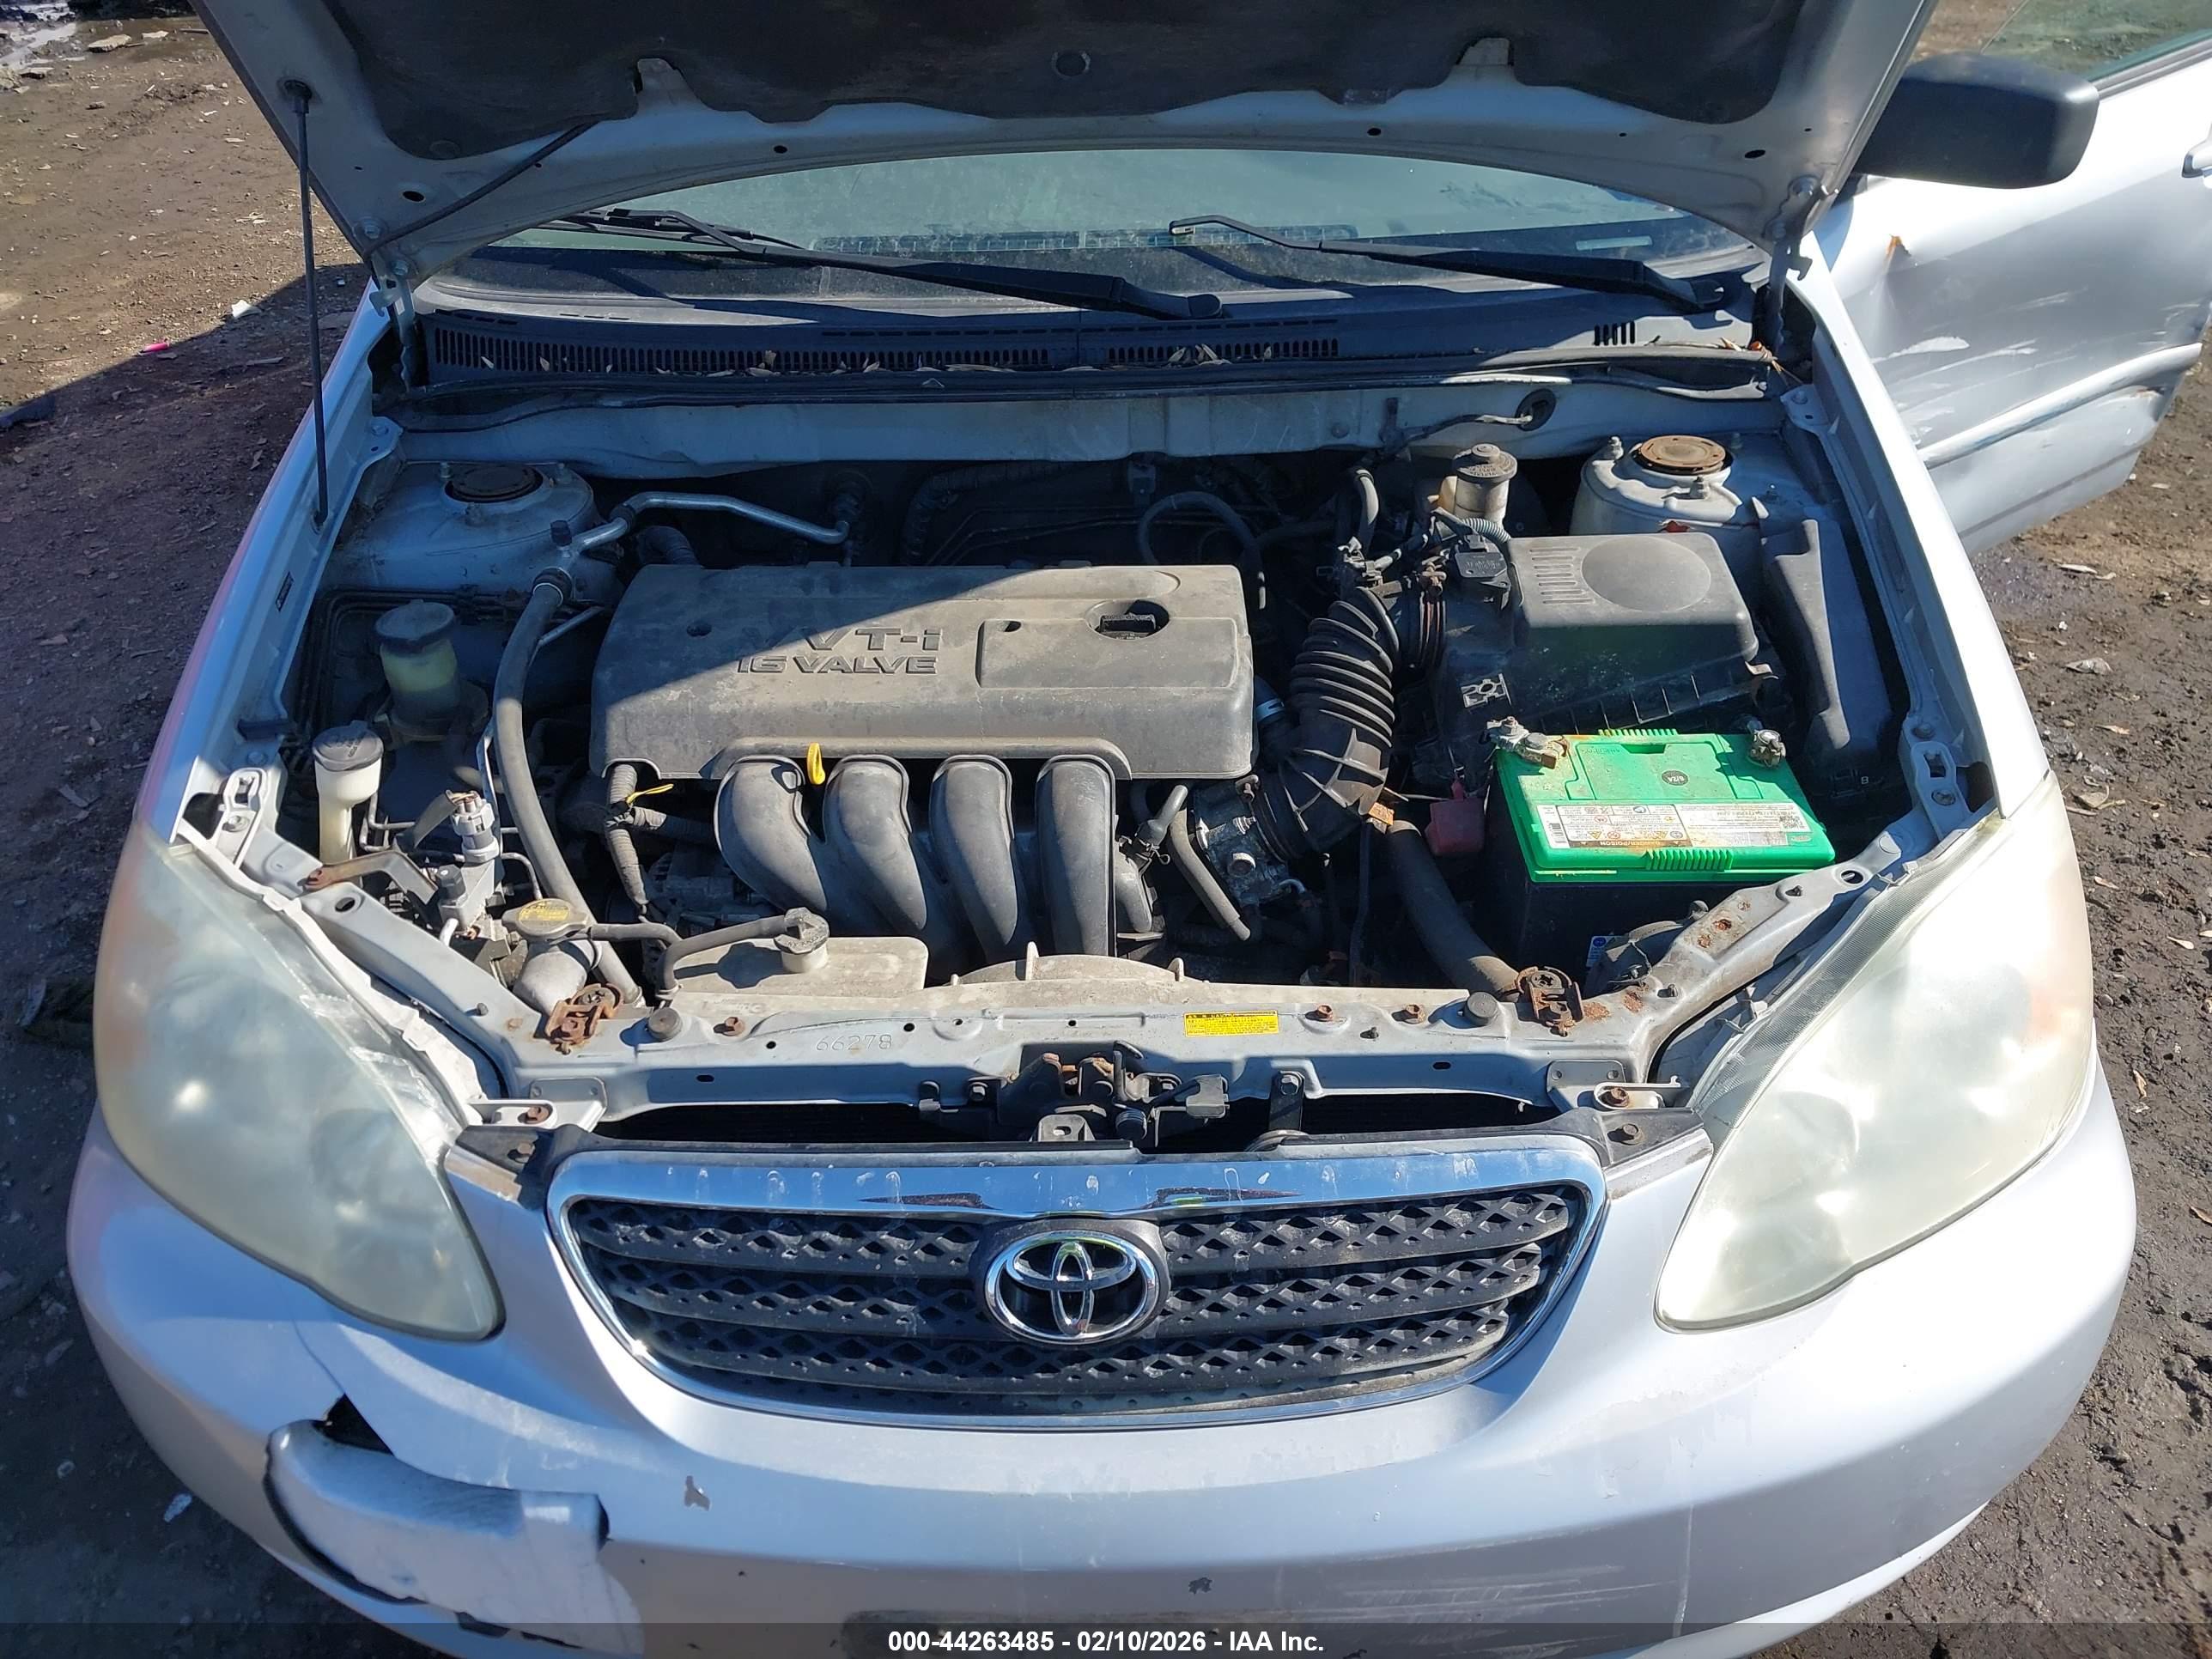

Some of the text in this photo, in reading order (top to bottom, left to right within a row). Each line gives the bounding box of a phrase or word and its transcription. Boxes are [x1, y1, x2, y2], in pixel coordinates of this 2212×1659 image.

[738, 656, 938, 673] 16 VALVE
[816, 1033, 892, 1051] 66278
